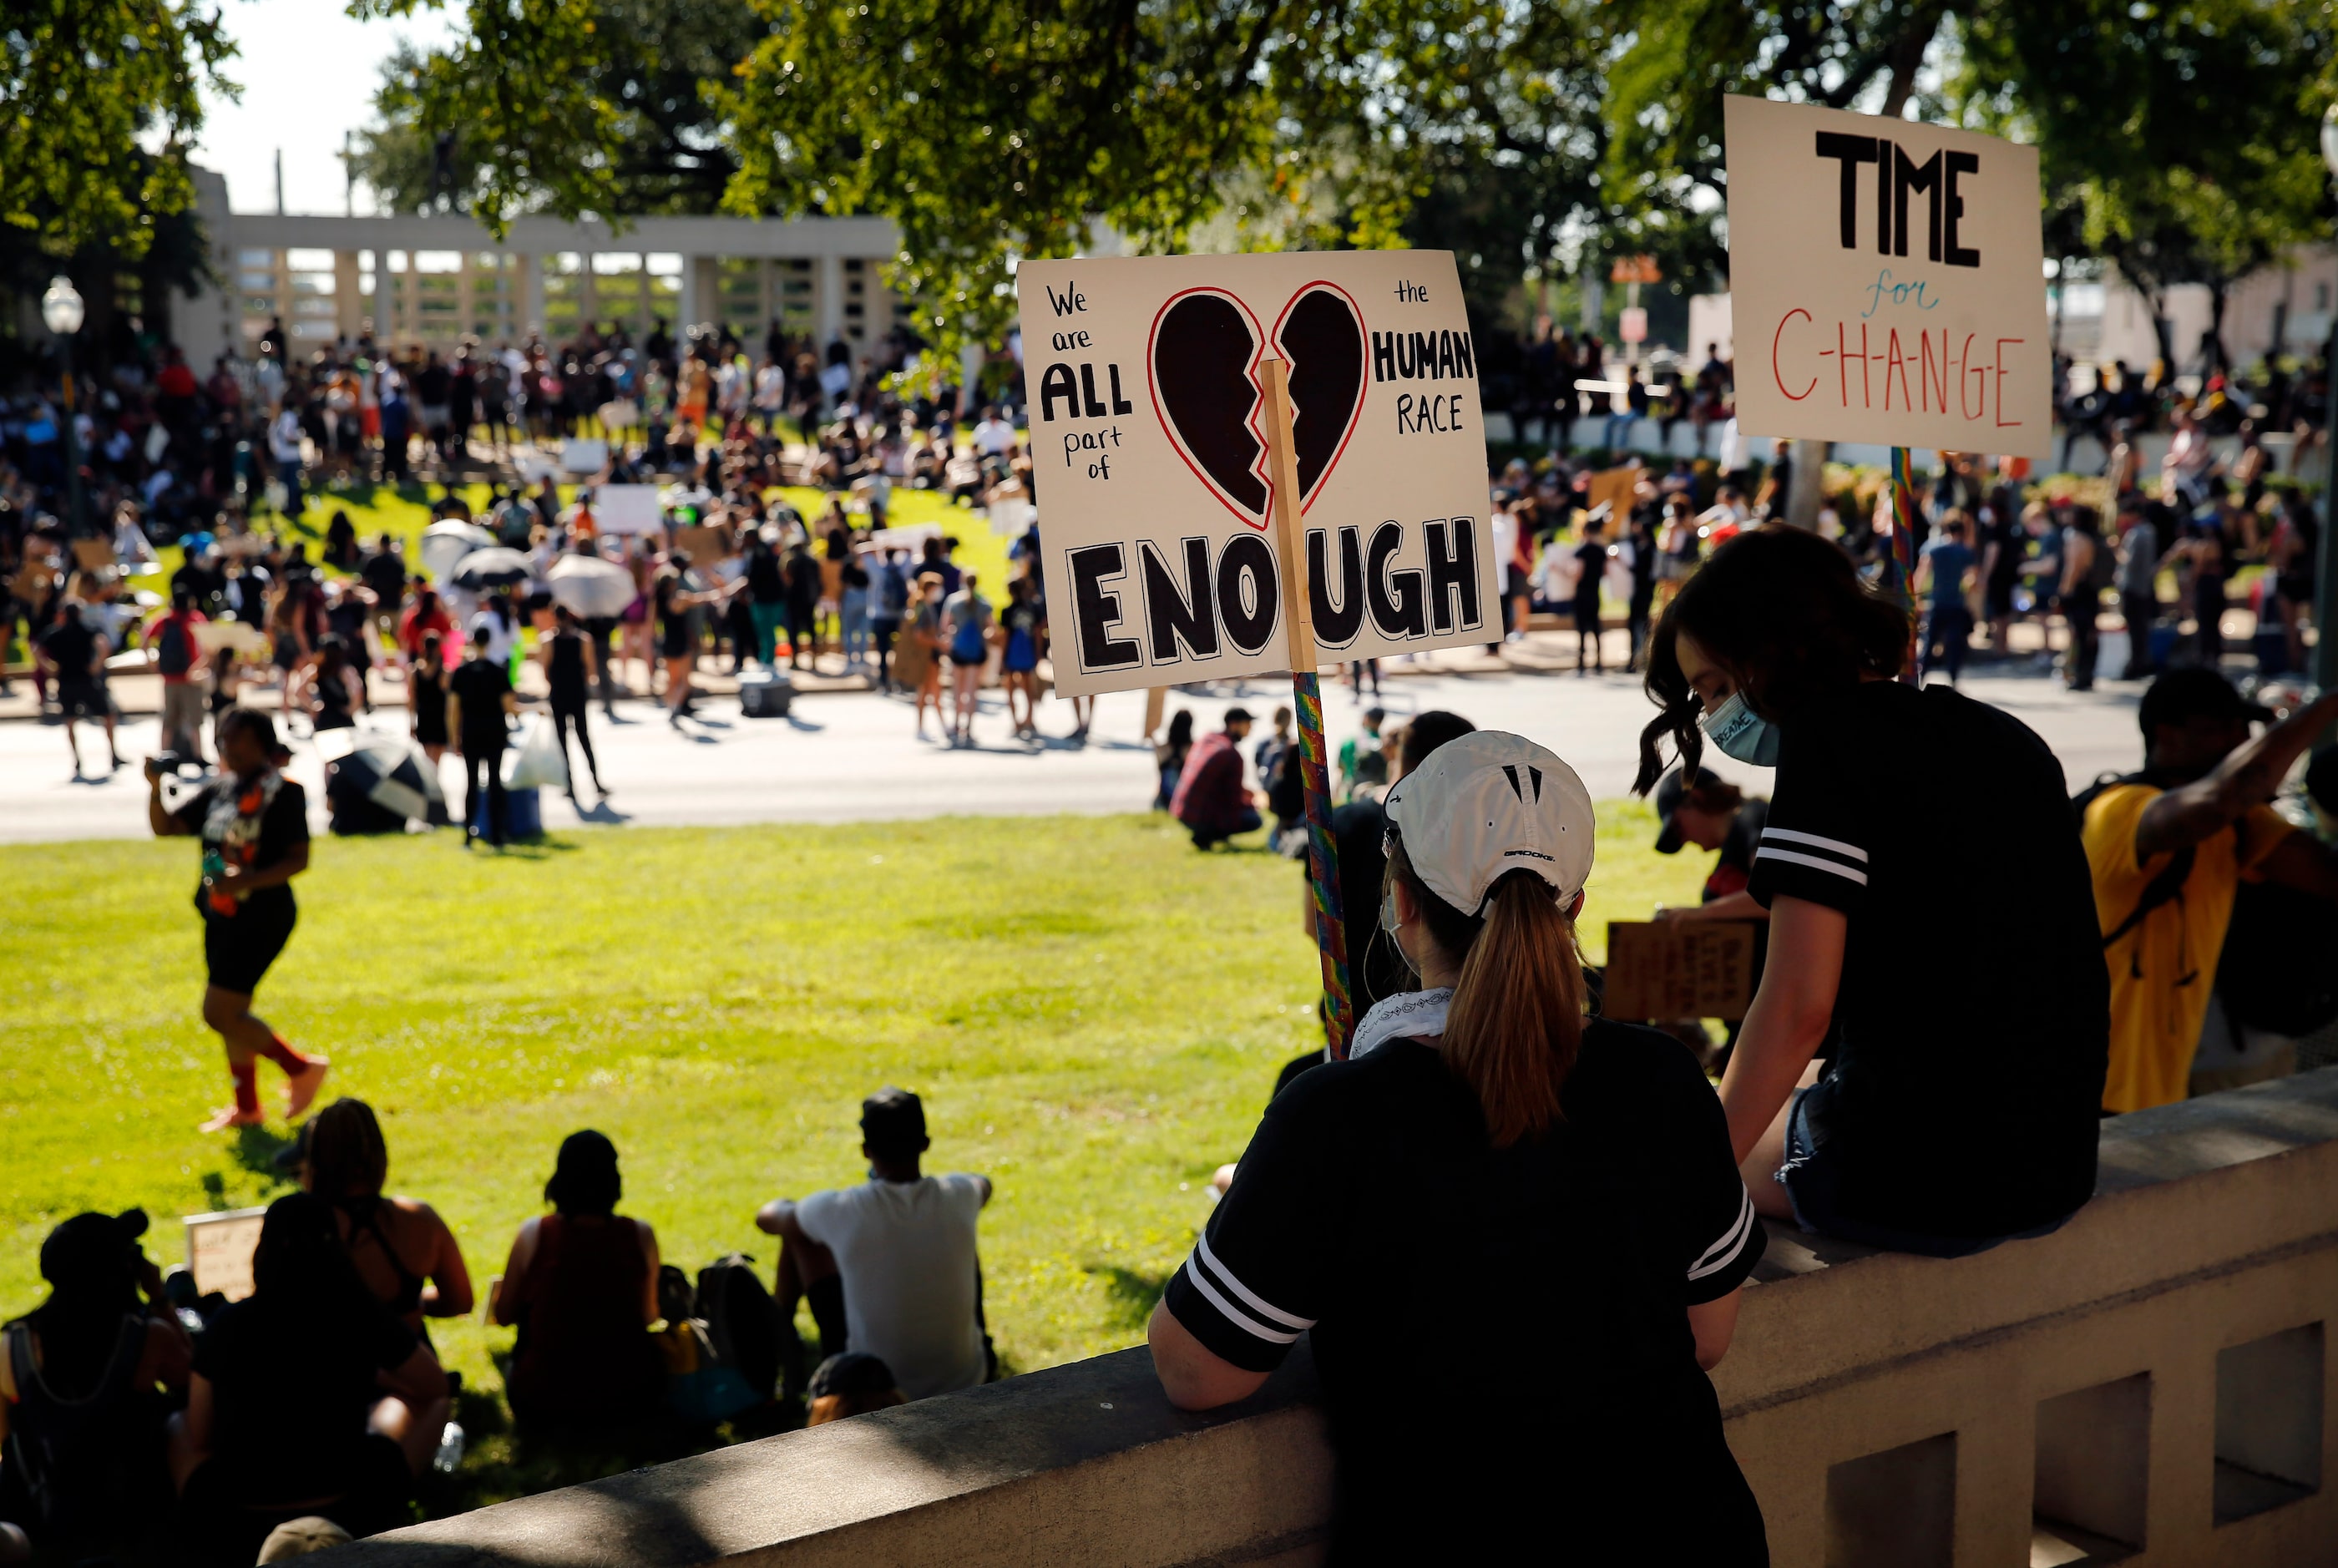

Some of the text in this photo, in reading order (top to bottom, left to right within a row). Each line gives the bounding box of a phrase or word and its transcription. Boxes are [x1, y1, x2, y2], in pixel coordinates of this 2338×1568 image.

[1816, 130, 1980, 267] TIME
[1046, 281, 1087, 316] We
[1394, 280, 1429, 302] the
[1861, 268, 1939, 317] for
[1053, 331, 1092, 351] are
[1372, 330, 1475, 382] HUMAN
[1773, 308, 2024, 427] C-H-A-N-G-E
[1040, 363, 1132, 422] ALL
[1397, 394, 1464, 435] RACE
[1064, 426, 1122, 467] part
[1088, 455, 1111, 480] of
[1066, 516, 1482, 675] ENOUGH
